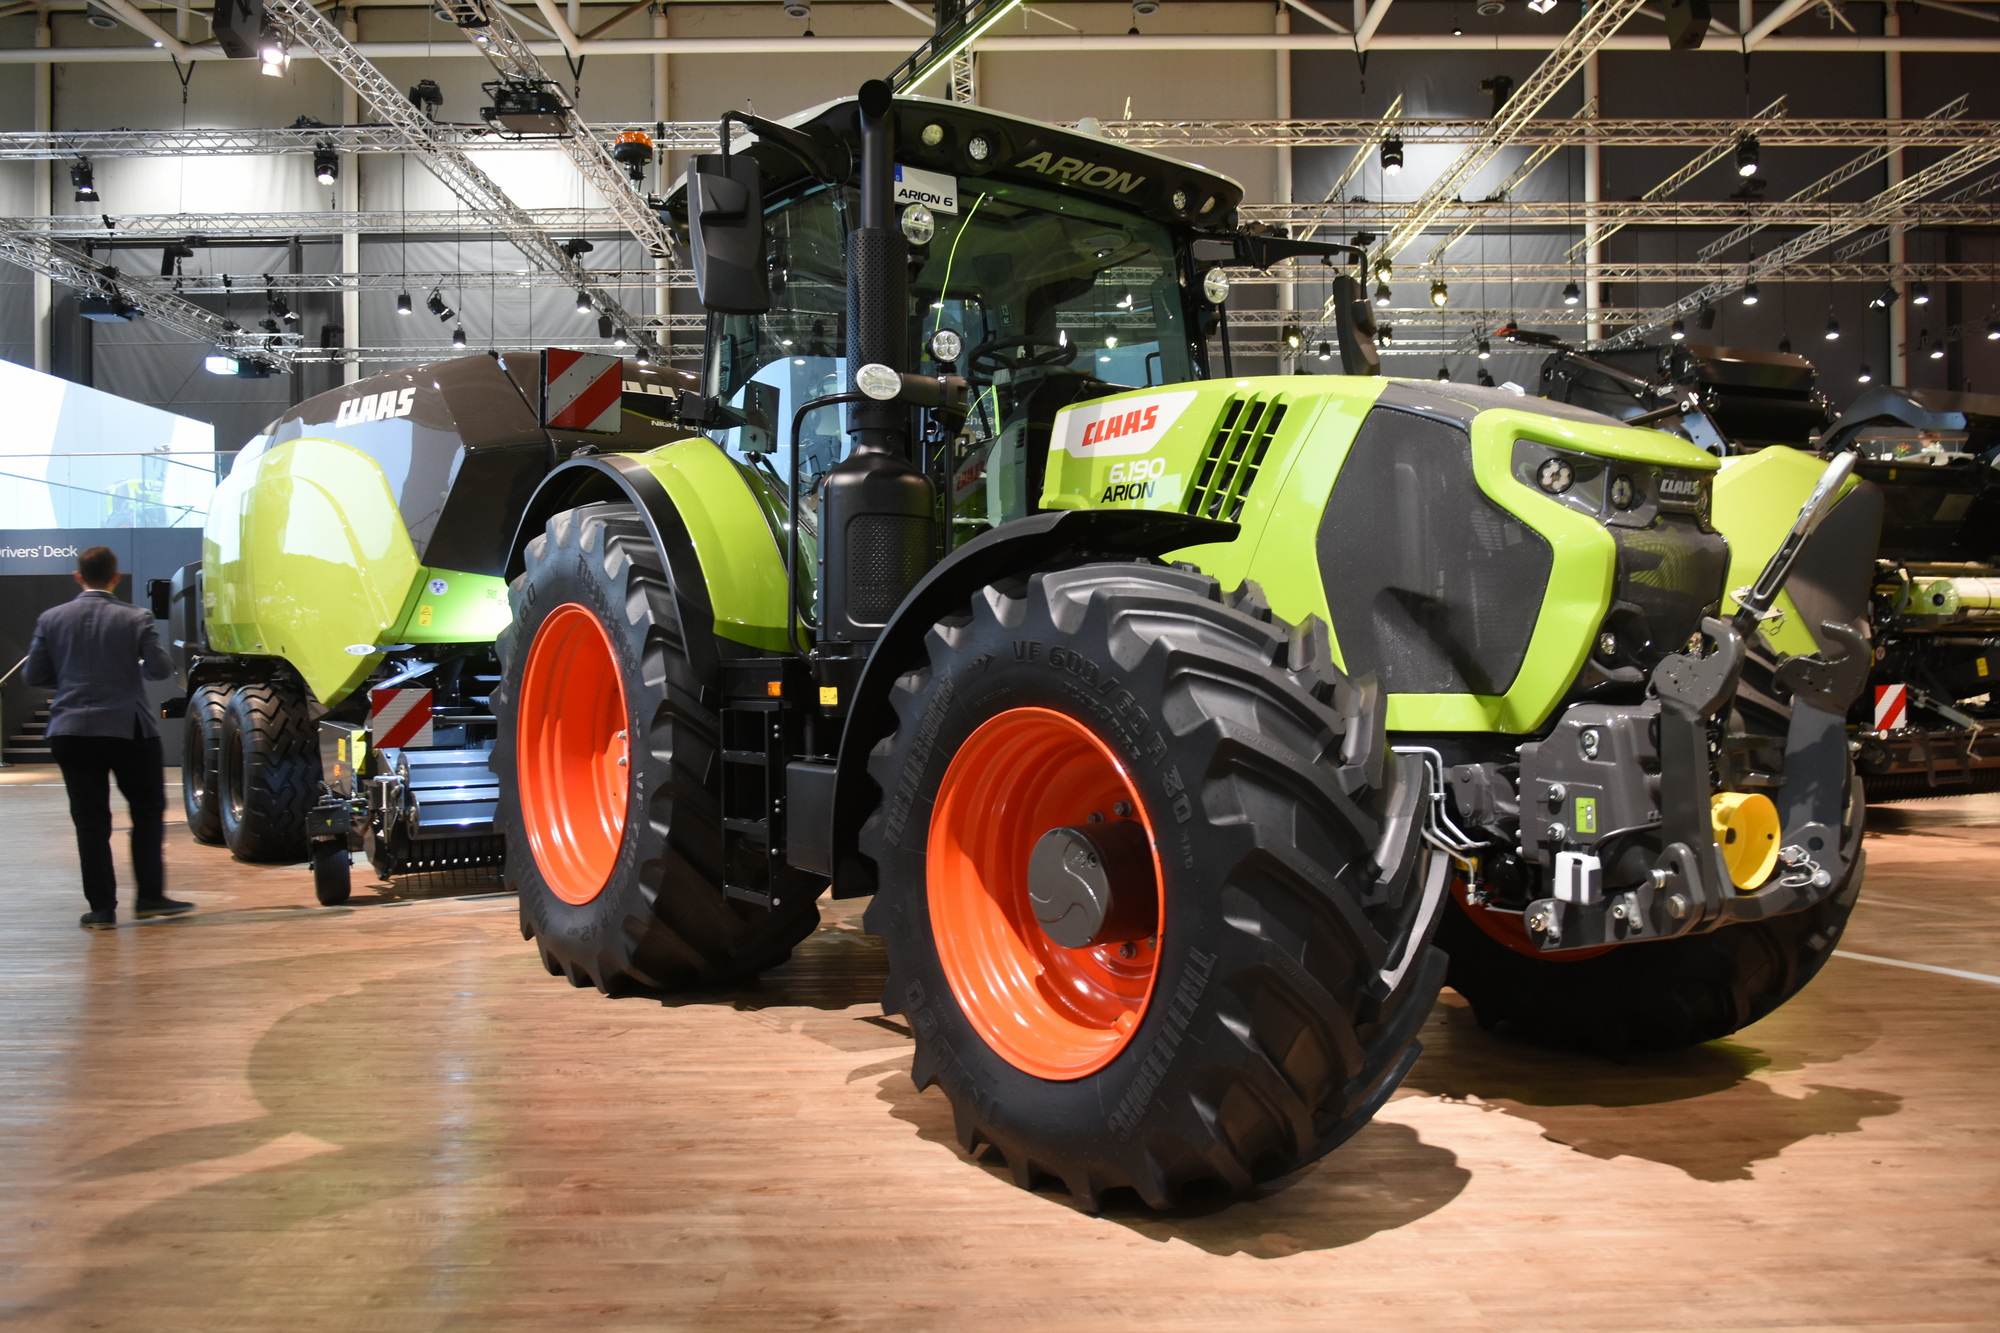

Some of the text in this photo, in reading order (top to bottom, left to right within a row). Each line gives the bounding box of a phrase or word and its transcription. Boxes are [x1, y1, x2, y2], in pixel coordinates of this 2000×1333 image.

[1015, 151, 1146, 194] ARION
[898, 188, 954, 207] ARION 6
[335, 387, 416, 428] CLAAS
[1082, 405, 1159, 447] CLAAS
[1109, 457, 1166, 484] 6.190
[1101, 481, 1156, 504] ARION
[1660, 479, 1698, 496] CLAAS
[0, 545, 78, 558] rivers' Deck
[1013, 640, 1042, 664] VF
